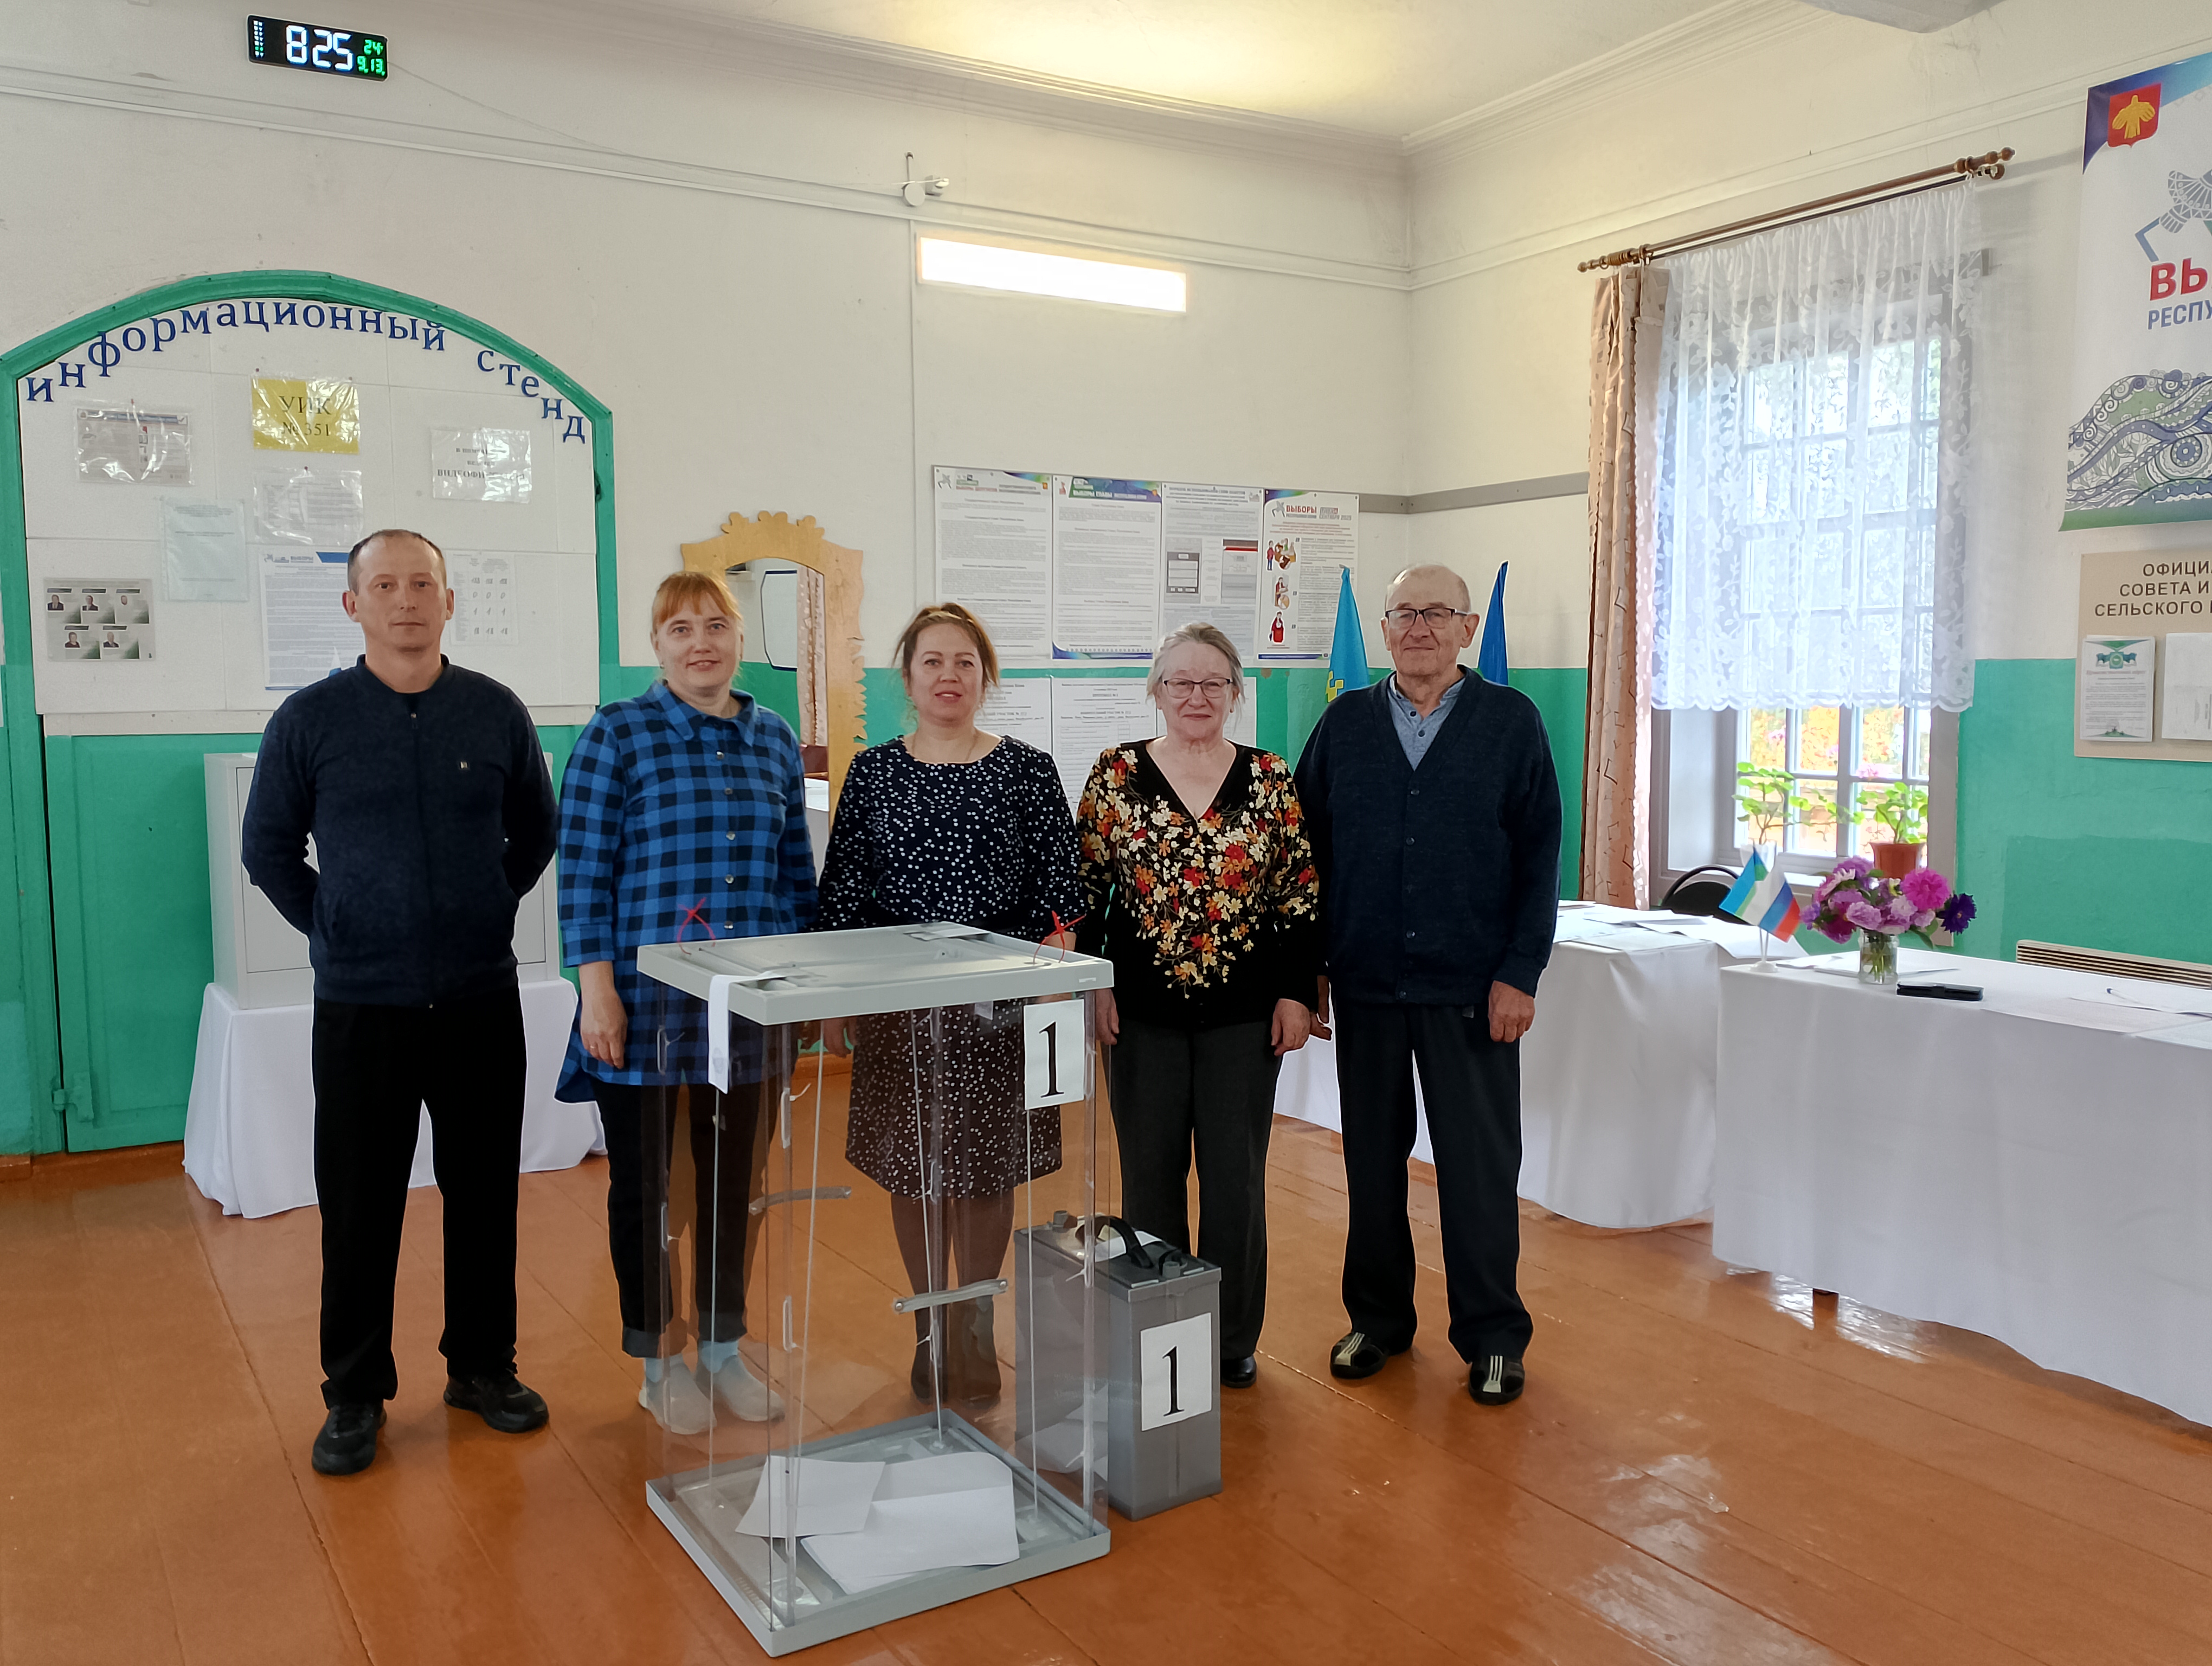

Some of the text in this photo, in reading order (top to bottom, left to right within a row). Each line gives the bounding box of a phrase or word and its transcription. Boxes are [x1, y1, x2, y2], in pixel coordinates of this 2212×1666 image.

[25, 301, 586, 444] информационный стенд
[279, 395, 332, 415] УИК
[304, 422, 330, 437] 351
[1286, 505, 1317, 514] ВЫБОРЫ
[2143, 560, 2212, 577] ОФИЦИ
[2120, 580, 2209, 597] СОВЕТА И
[2095, 600, 2203, 617] СЕЛЬСКОГО
[1038, 1021, 1064, 1098] 1
[1162, 1345, 1185, 1417] 1
